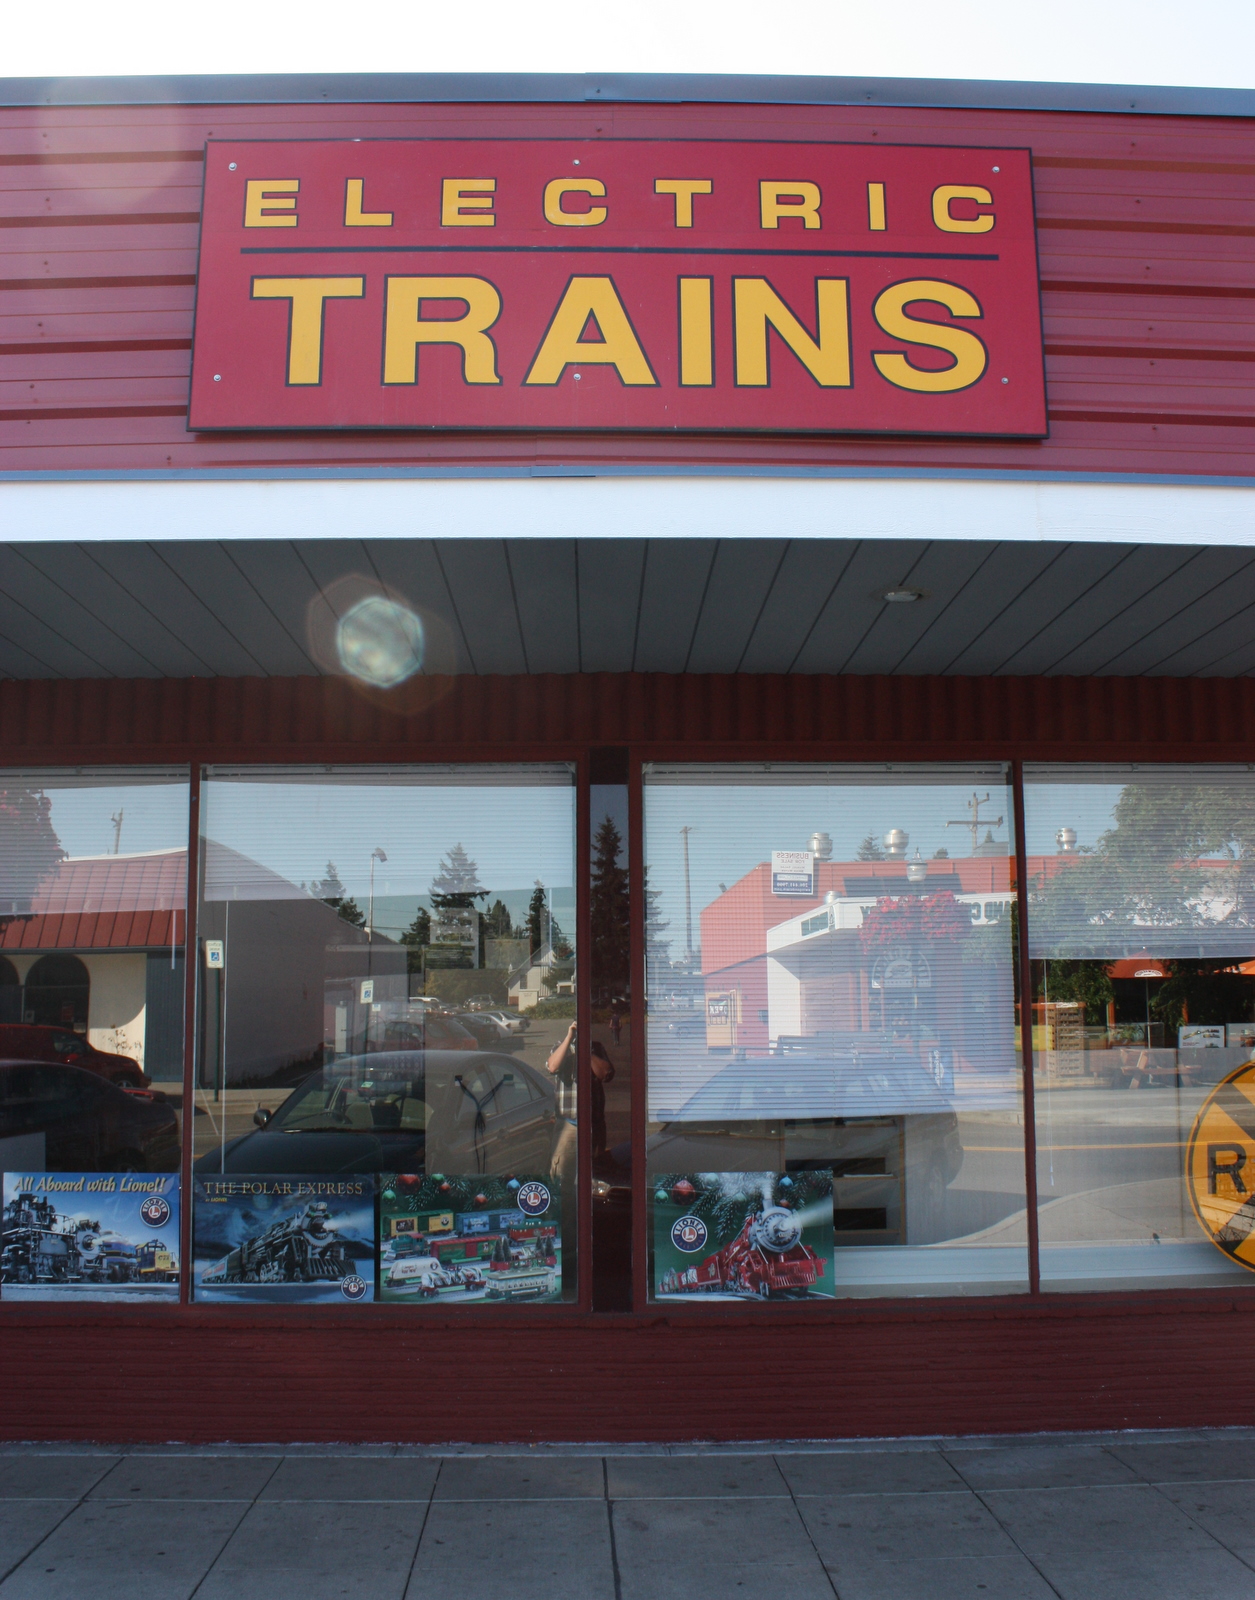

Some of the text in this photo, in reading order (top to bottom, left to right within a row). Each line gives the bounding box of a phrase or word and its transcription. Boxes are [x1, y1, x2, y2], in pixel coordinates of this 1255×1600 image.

[243, 177, 997, 234] ELECTRIC
[249, 273, 990, 393] TRAINS
[1207, 1143, 1247, 1194] R
[13, 1176, 166, 1193] All Aboard with Lionel!
[204, 1182, 363, 1195] THE POLAR EXPRESS
[521, 1185, 546, 1197] LIONEL
[675, 1219, 703, 1232] LIONEL
